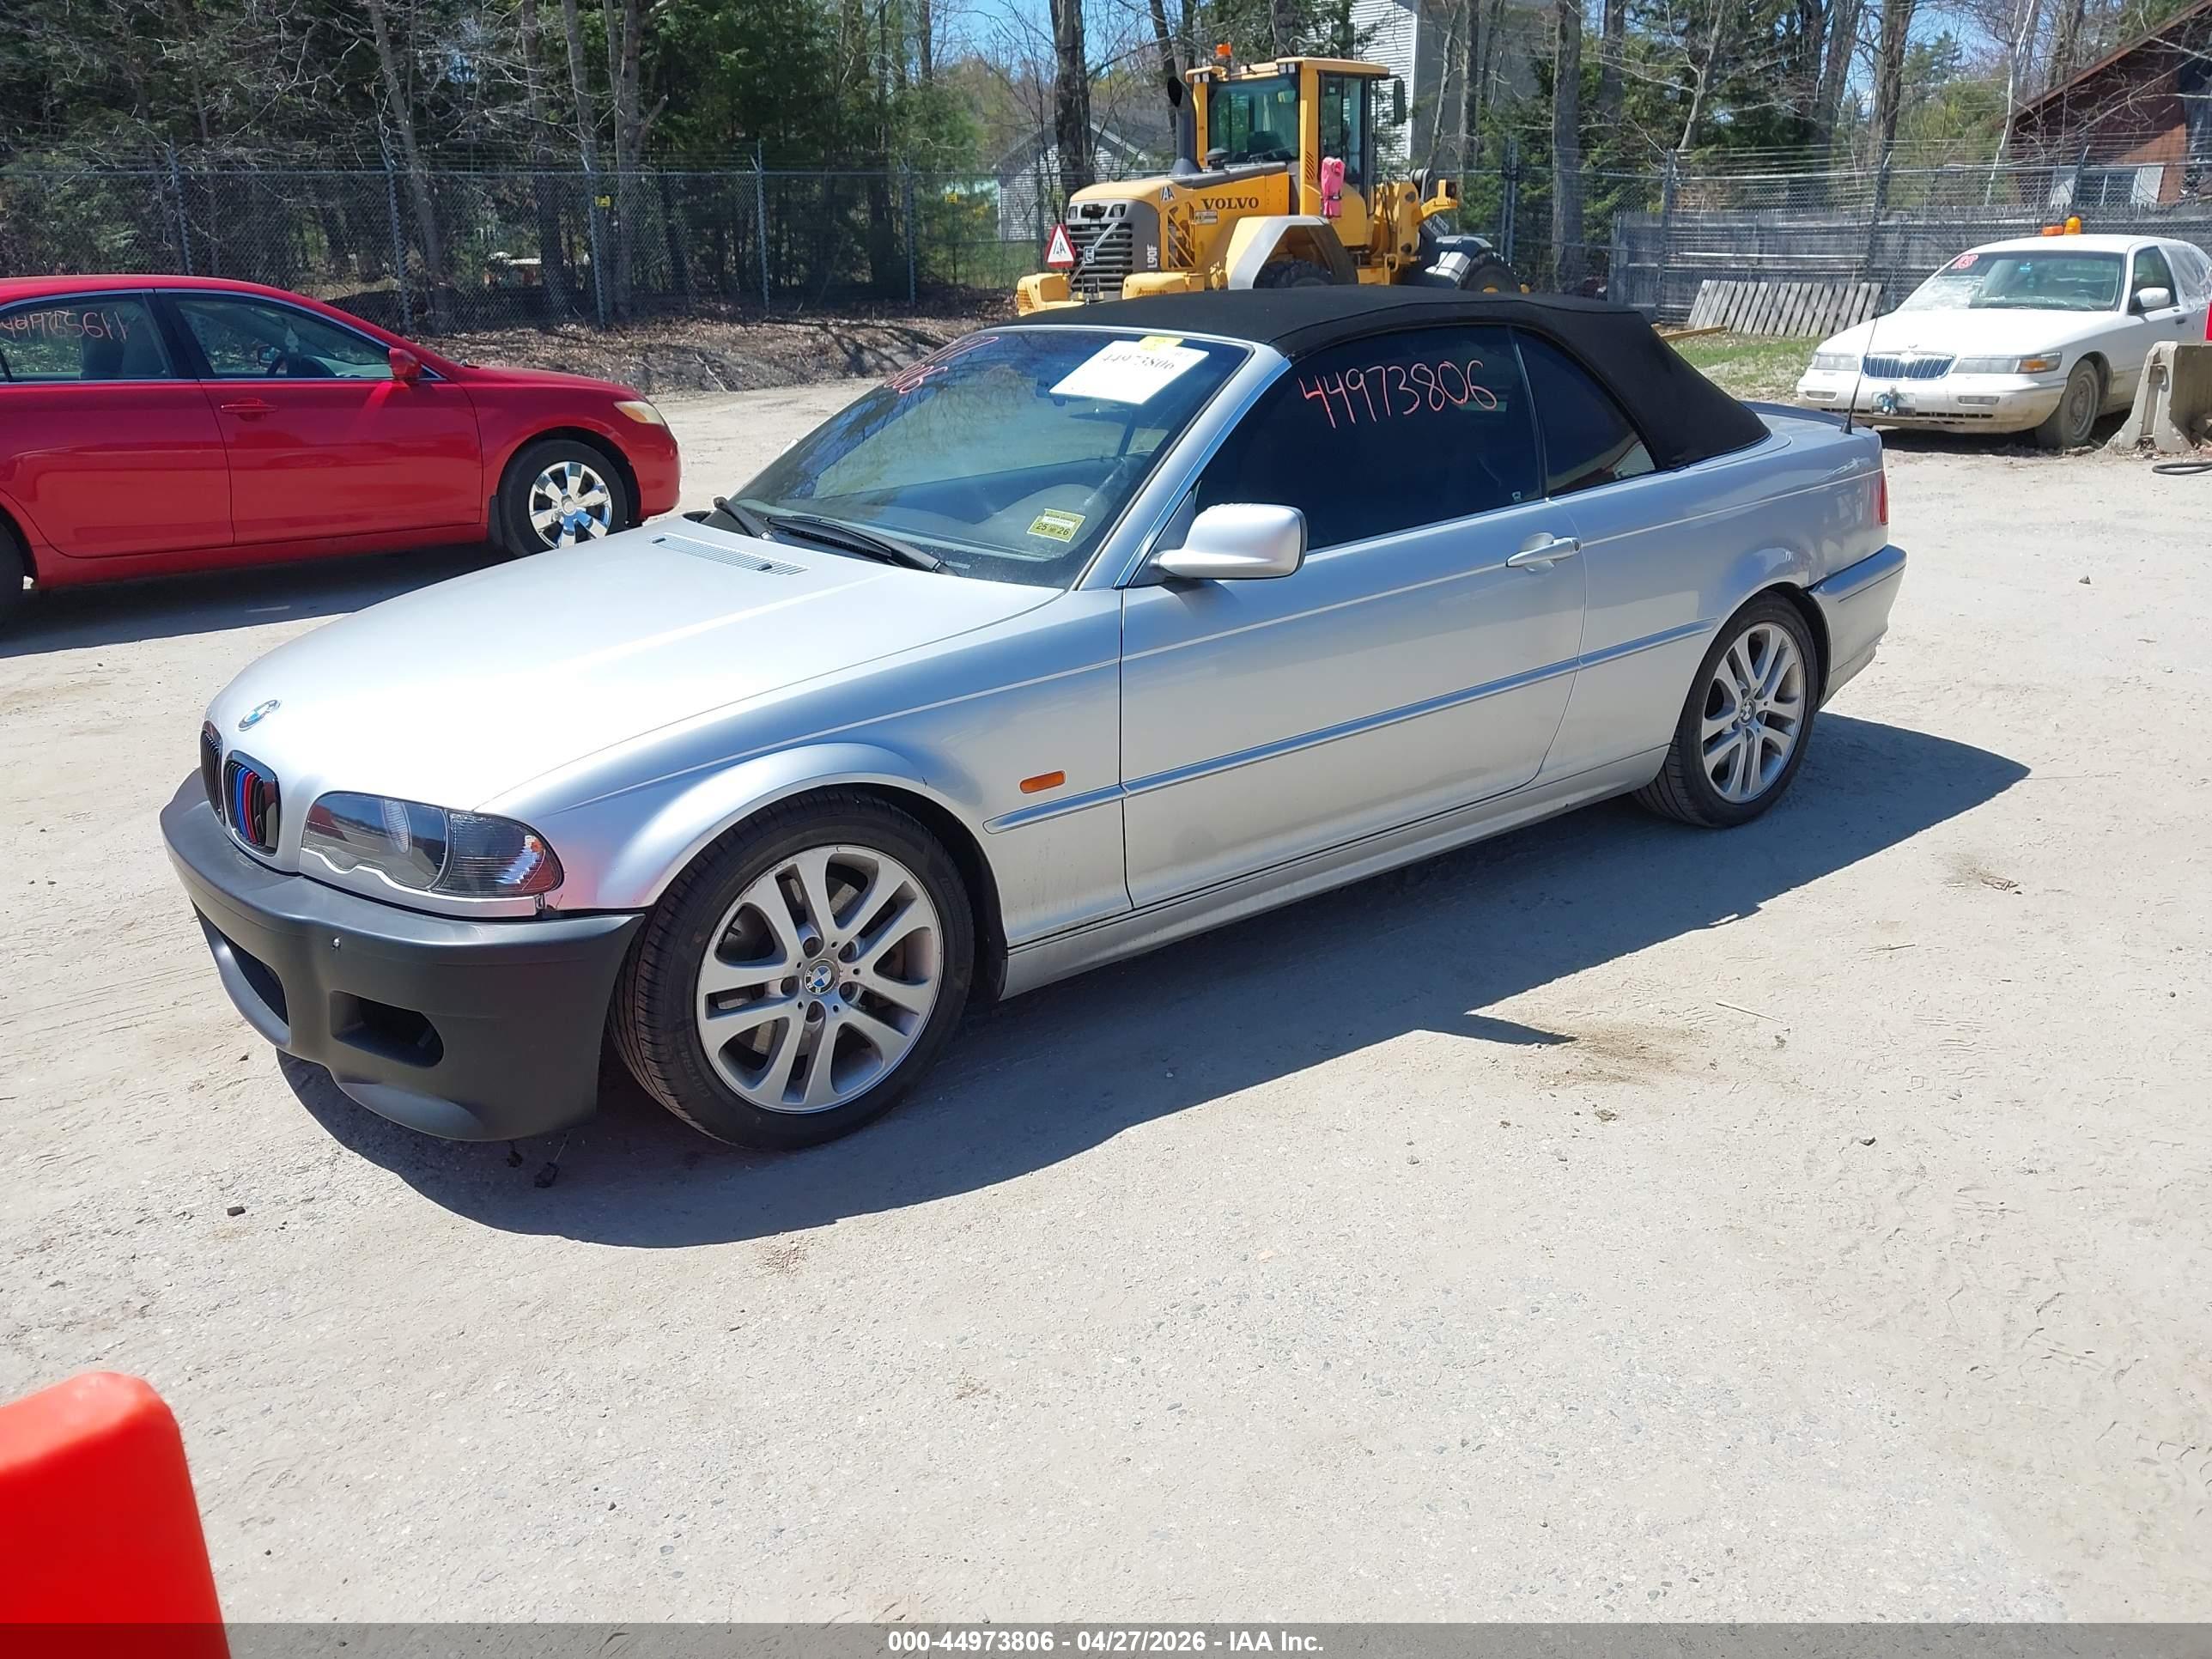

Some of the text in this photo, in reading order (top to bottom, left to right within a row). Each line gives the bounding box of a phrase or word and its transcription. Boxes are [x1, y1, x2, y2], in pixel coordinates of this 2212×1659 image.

[1201, 197, 1260, 210] VOLVO
[1147, 243, 1158, 269] L90F
[1298, 360, 1498, 429] 44973806
[1036, 522, 1048, 531] 25
[1057, 526, 1071, 536] 26
